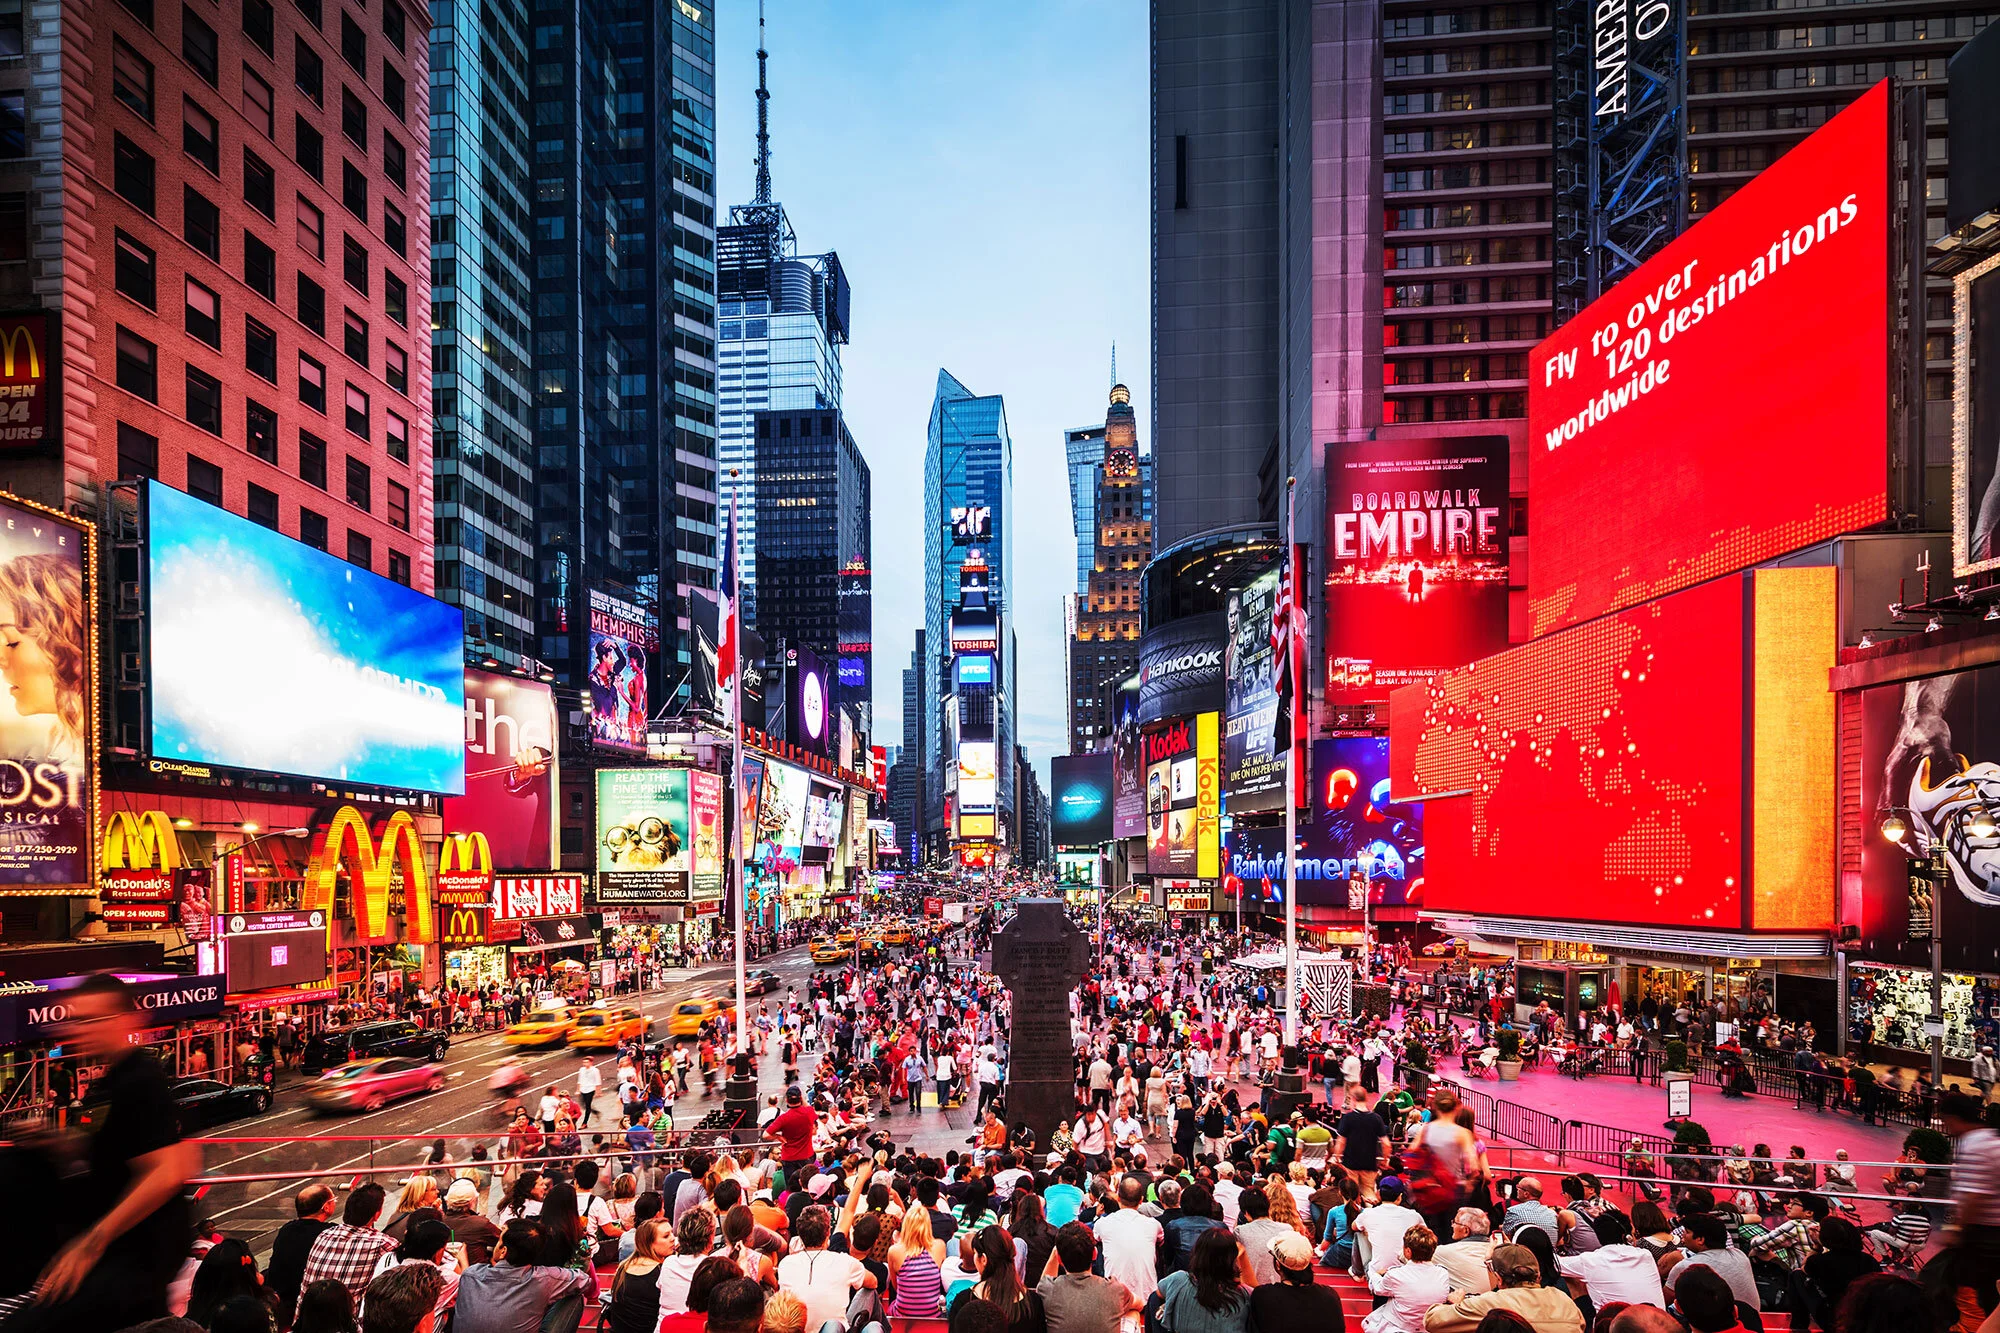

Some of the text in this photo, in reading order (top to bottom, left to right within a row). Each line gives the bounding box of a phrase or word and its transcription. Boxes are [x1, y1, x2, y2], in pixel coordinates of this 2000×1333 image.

[1605, 193, 1858, 379] 120 destinations
[1545, 259, 1698, 388] Fly to over
[1545, 359, 1670, 451] worldwide
[1352, 489, 1480, 511] BOARDWALK
[1334, 507, 1500, 559] EMPIRE
[590, 598, 645, 625] BEST MUSICAL
[591, 611, 645, 645] MEMPHIS
[953, 641, 995, 649] TOSHIBA
[1150, 719, 1191, 761] Kodak
[1246, 727, 1268, 750] UFC
[615, 773, 669, 783] READ THE
[1231, 771, 1241, 781] LIVE
[1241, 768, 1250, 779] ON
[1251, 759, 1287, 776] PAY-PER-VIEW
[612, 784, 673, 794] FINE PRINT
[1199, 757, 1216, 836] Kodak
[15, 845, 77, 854] 877-250-2929
[102, 878, 170, 890] McDonald's
[439, 876, 488, 884] McDonald's
[603, 890, 686, 898] HUMANEWATCH.ORG
[1184, 898, 1209, 909] EVITA
[103, 910, 125, 918] OPEN
[138, 910, 166, 918] HOURS
[132, 986, 218, 1010] XCHANGE
